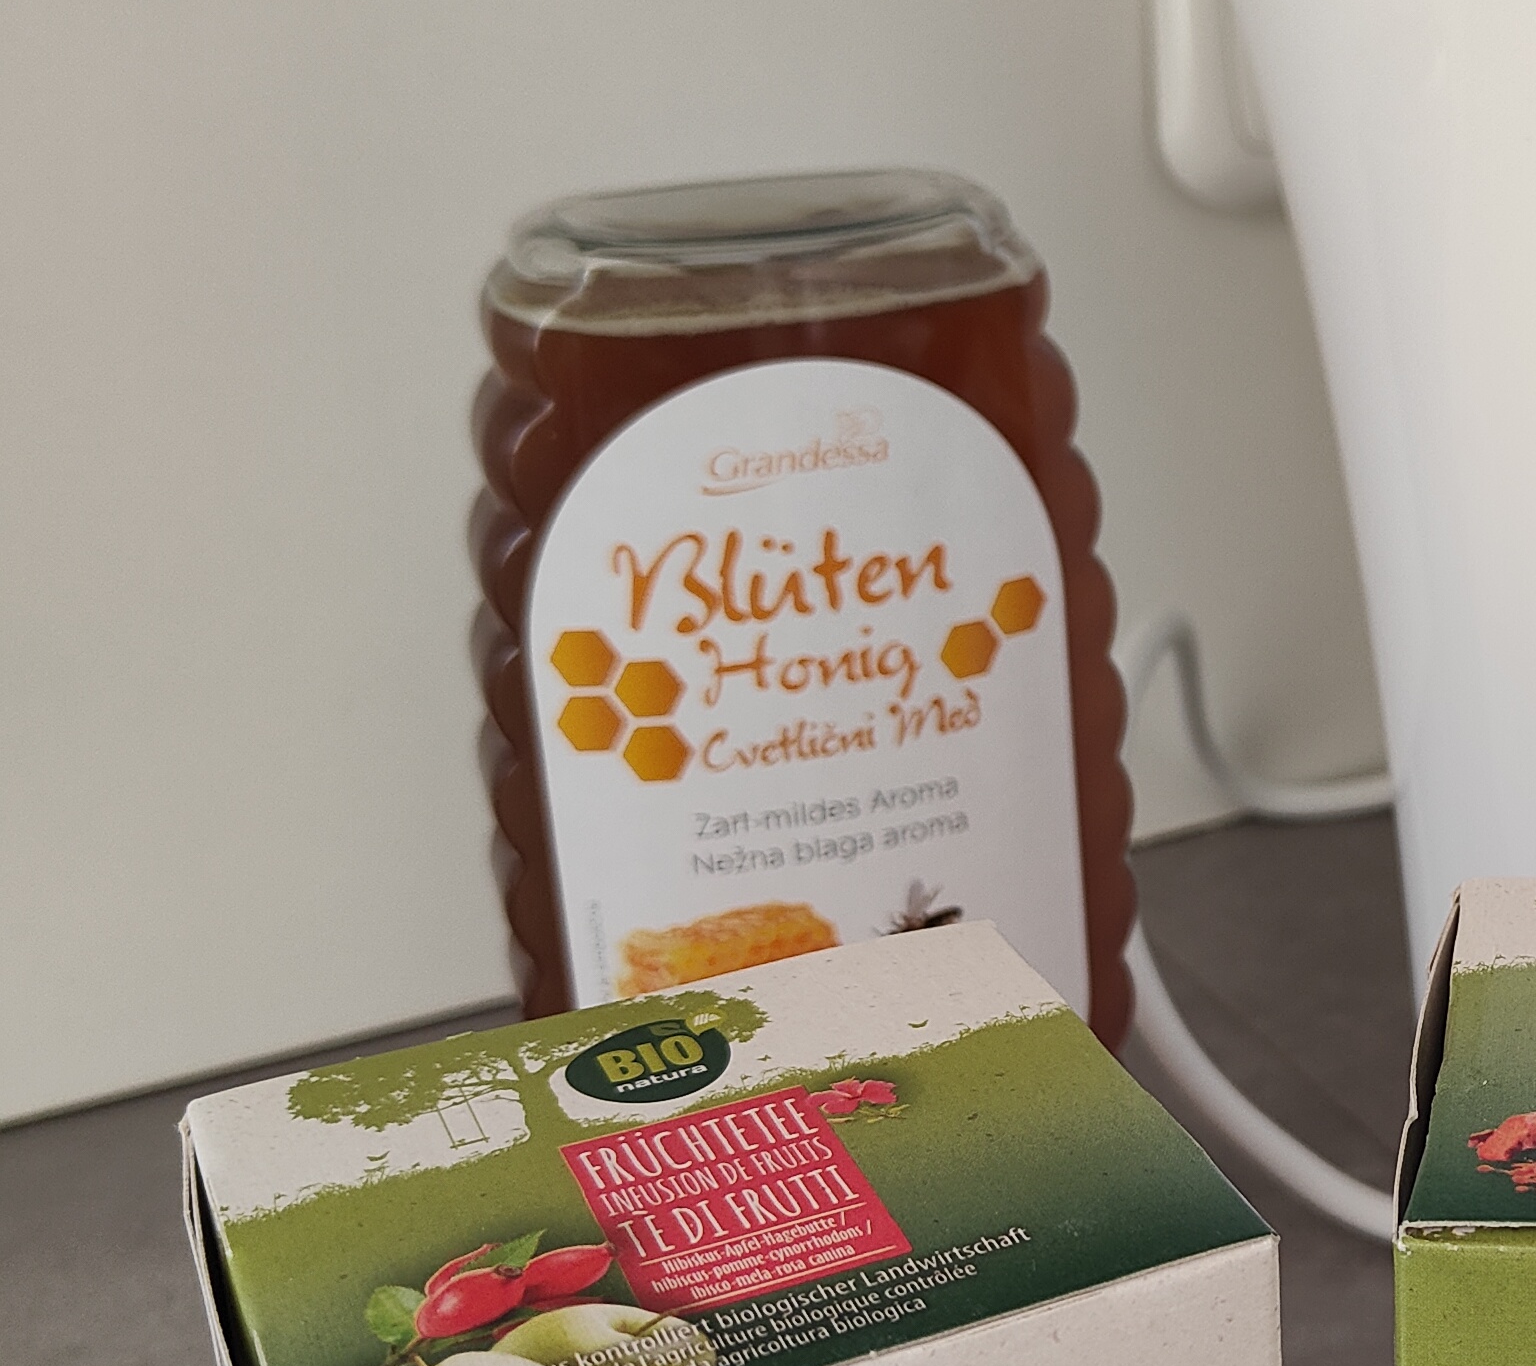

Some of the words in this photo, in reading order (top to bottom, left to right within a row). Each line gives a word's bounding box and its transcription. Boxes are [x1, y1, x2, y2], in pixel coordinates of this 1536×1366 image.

[704, 436, 890, 483] Grandessa
[613, 526, 951, 635] Blüten
[700, 628, 919, 705] Honig
[702, 711, 876, 773] Cvetlični
[694, 796, 861, 839] Zart-mildes
[870, 775, 959, 813] Aroma
[692, 845, 785, 875] Nežna
[793, 831, 874, 865] blaga
[882, 810, 970, 848] aroma
[597, 1035, 704, 1082] BIO
[616, 1063, 708, 1094] natura
[578, 1098, 819, 1190] FRÜCHTETEE
[600, 1166, 719, 1216] INFUSION
[717, 1157, 753, 1185] DE
[750, 1136, 833, 1176] FRUITS
[672, 1200, 729, 1244] DI
[724, 1165, 860, 1230] FRUTTI
[651, 1225, 863, 1294] hibiscus-pomme-cynorrhodons
[661, 1215, 837, 1274] Hibiskus-Apfel-Hagebutte
[689, 1260, 806, 1301] ibisco-mela-rosa
[808, 1244, 856, 1267] canina
[716, 1277, 858, 1330] biologischer
[863, 1227, 1032, 1287] Landwirtschaft
[771, 1292, 880, 1332] biologique
[884, 1262, 978, 1298] contrôlée
[835, 1297, 927, 1334] biologica
